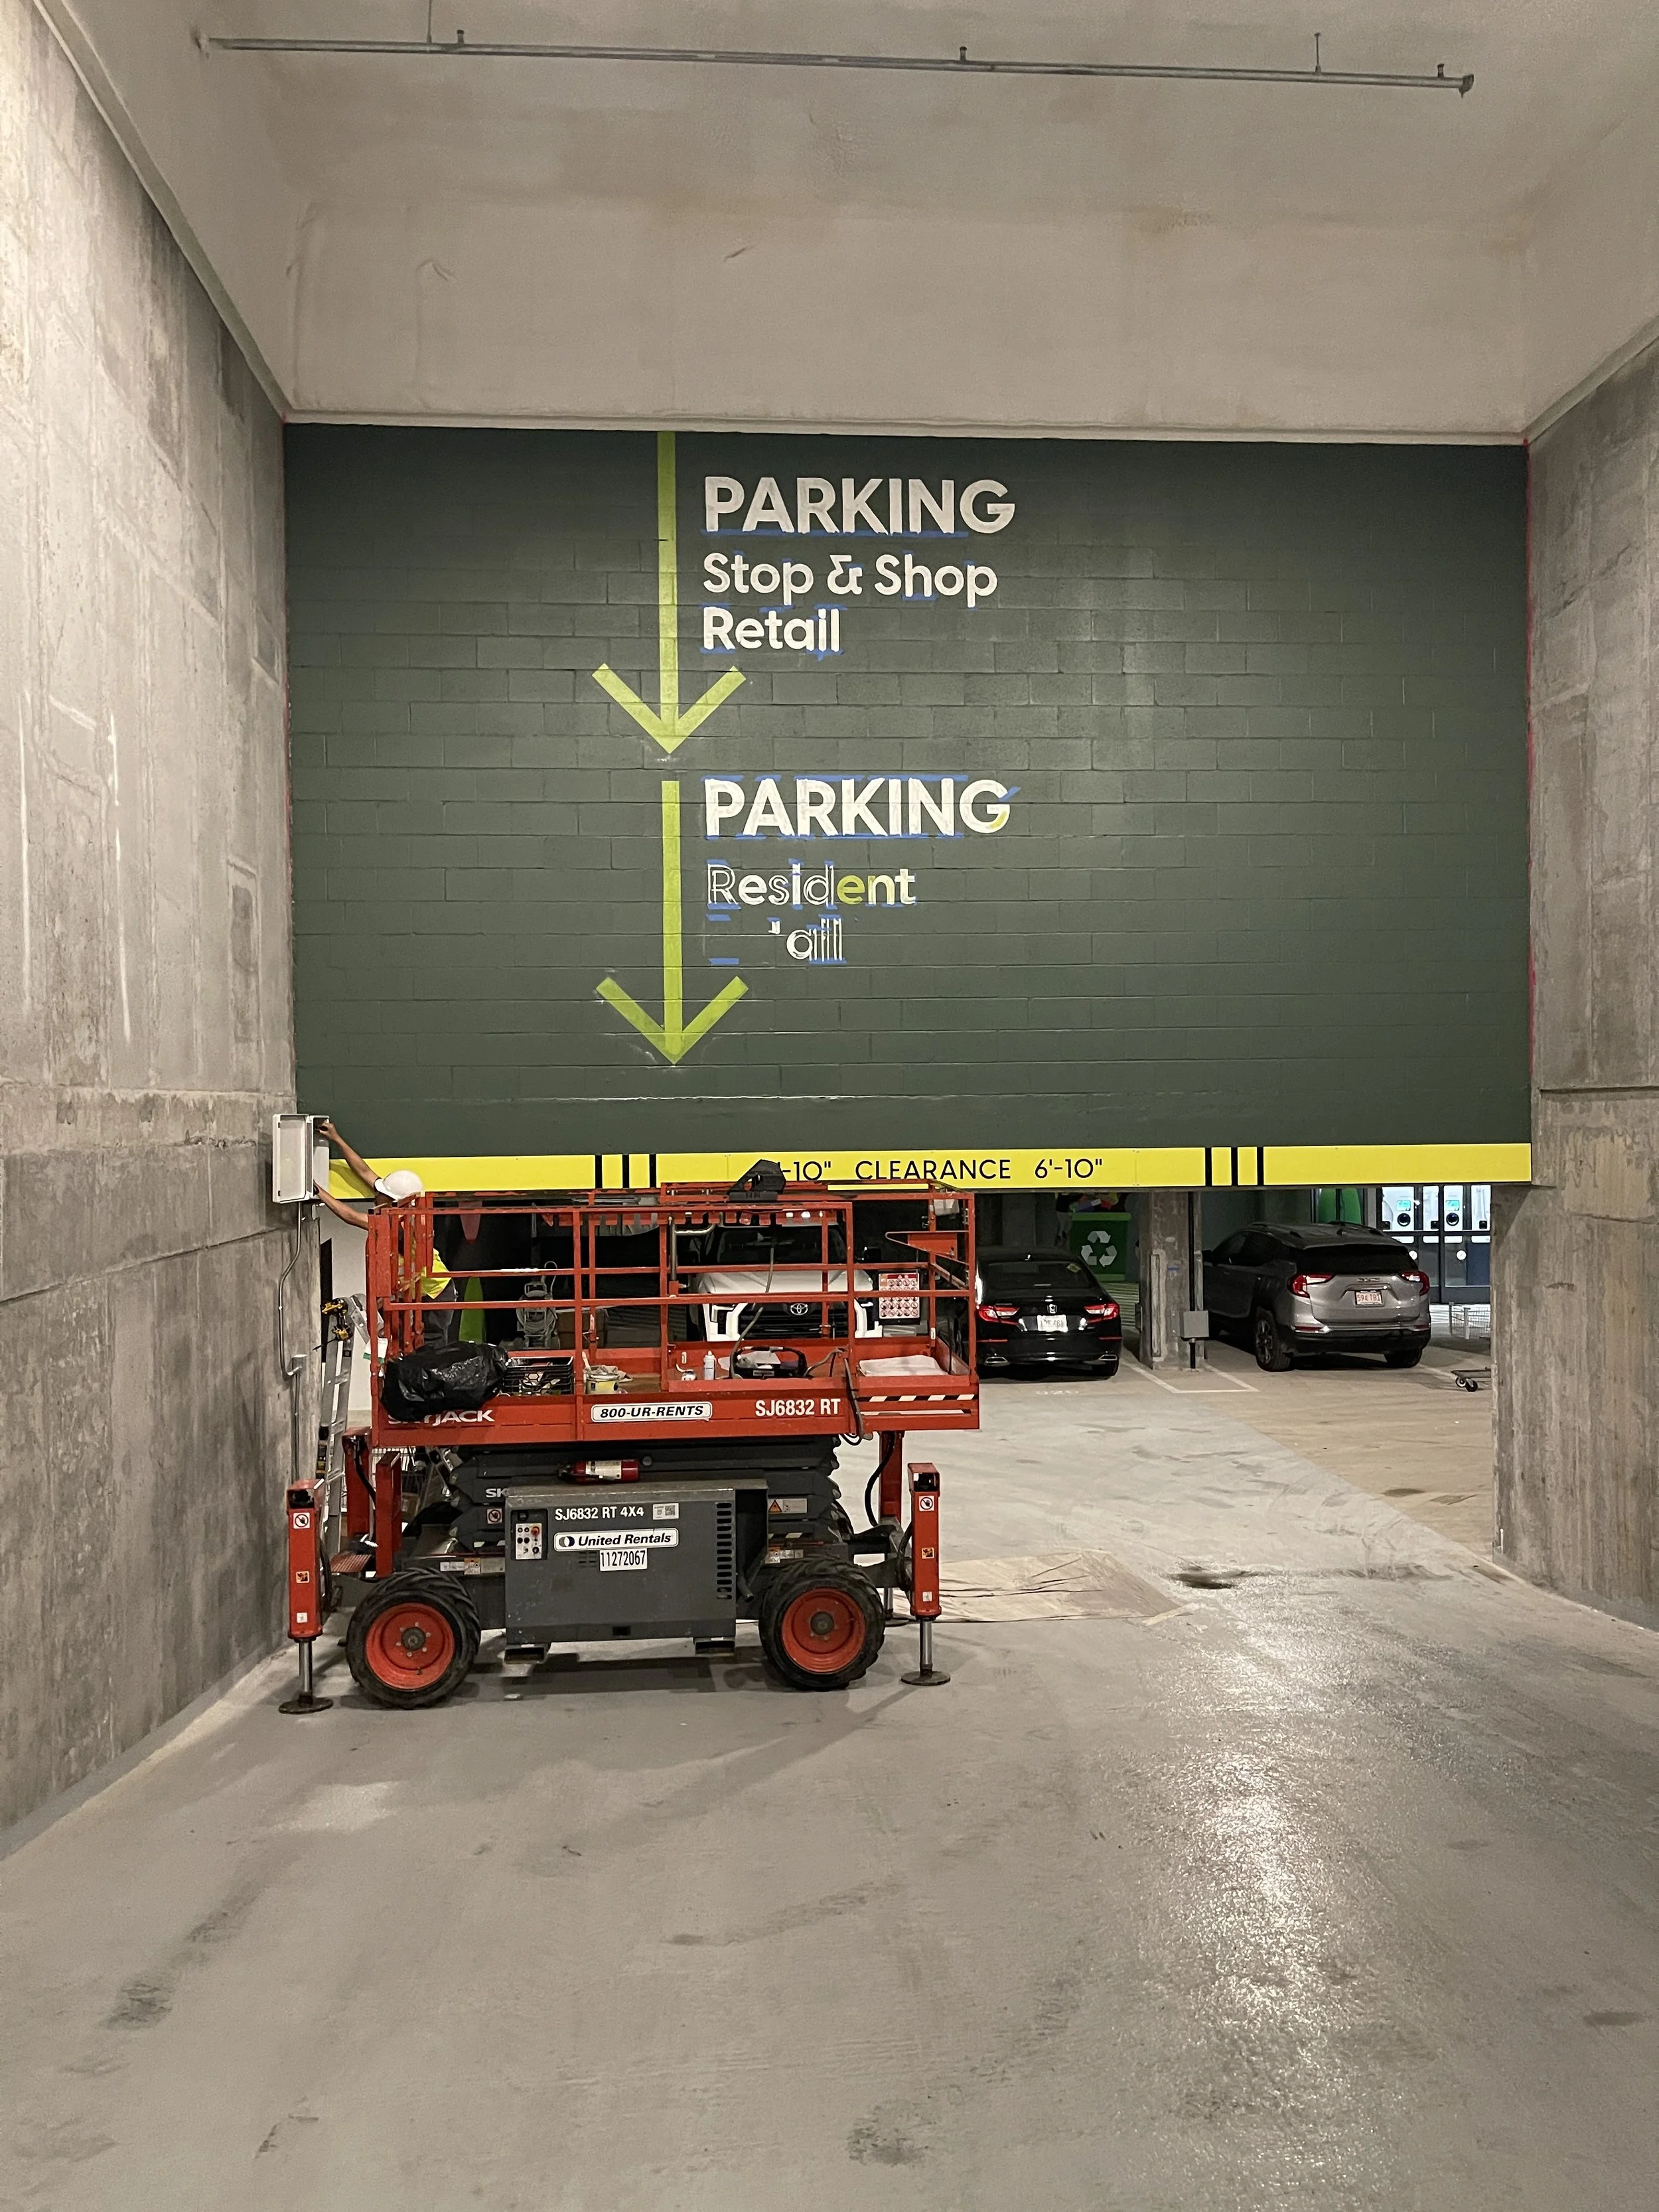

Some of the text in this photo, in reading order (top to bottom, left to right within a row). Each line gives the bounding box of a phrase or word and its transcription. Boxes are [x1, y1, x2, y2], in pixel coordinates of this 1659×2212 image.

[705, 476, 1015, 534] PARKING
[703, 552, 997, 608] Stop & Shop
[703, 606, 840, 652] Retail
[704, 777, 1010, 836] PARKING
[707, 863, 916, 907] Resident
[778, 1158, 1102, 1181] '-10" CLEARANCE 6'-10"
[600, 1406, 703, 1418] 800-UR-RENTS
[755, 1398, 841, 1416] SJ6832 RT
[388, 1410, 495, 1426] JACK
[555, 1507, 599, 1520] SJ6832
[602, 1506, 617, 1518] RT
[578, 1533, 672, 1546] United Rentals
[601, 1550, 646, 1567] 11272067
